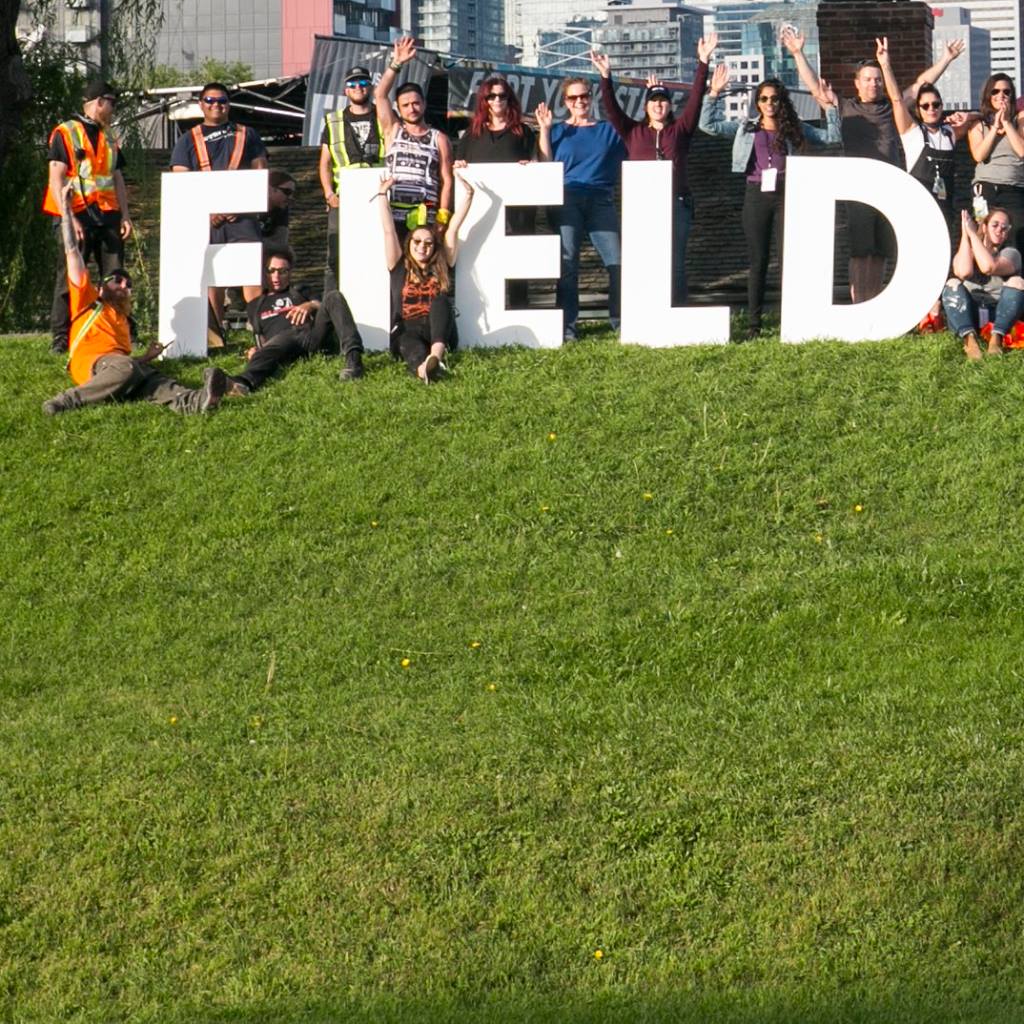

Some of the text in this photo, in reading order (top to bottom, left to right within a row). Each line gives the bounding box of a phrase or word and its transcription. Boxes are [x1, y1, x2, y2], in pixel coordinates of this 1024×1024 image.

[464, 71, 535, 114] FT
[542, 77, 602, 119] YOK
[158, 156, 951, 358] FIELD
